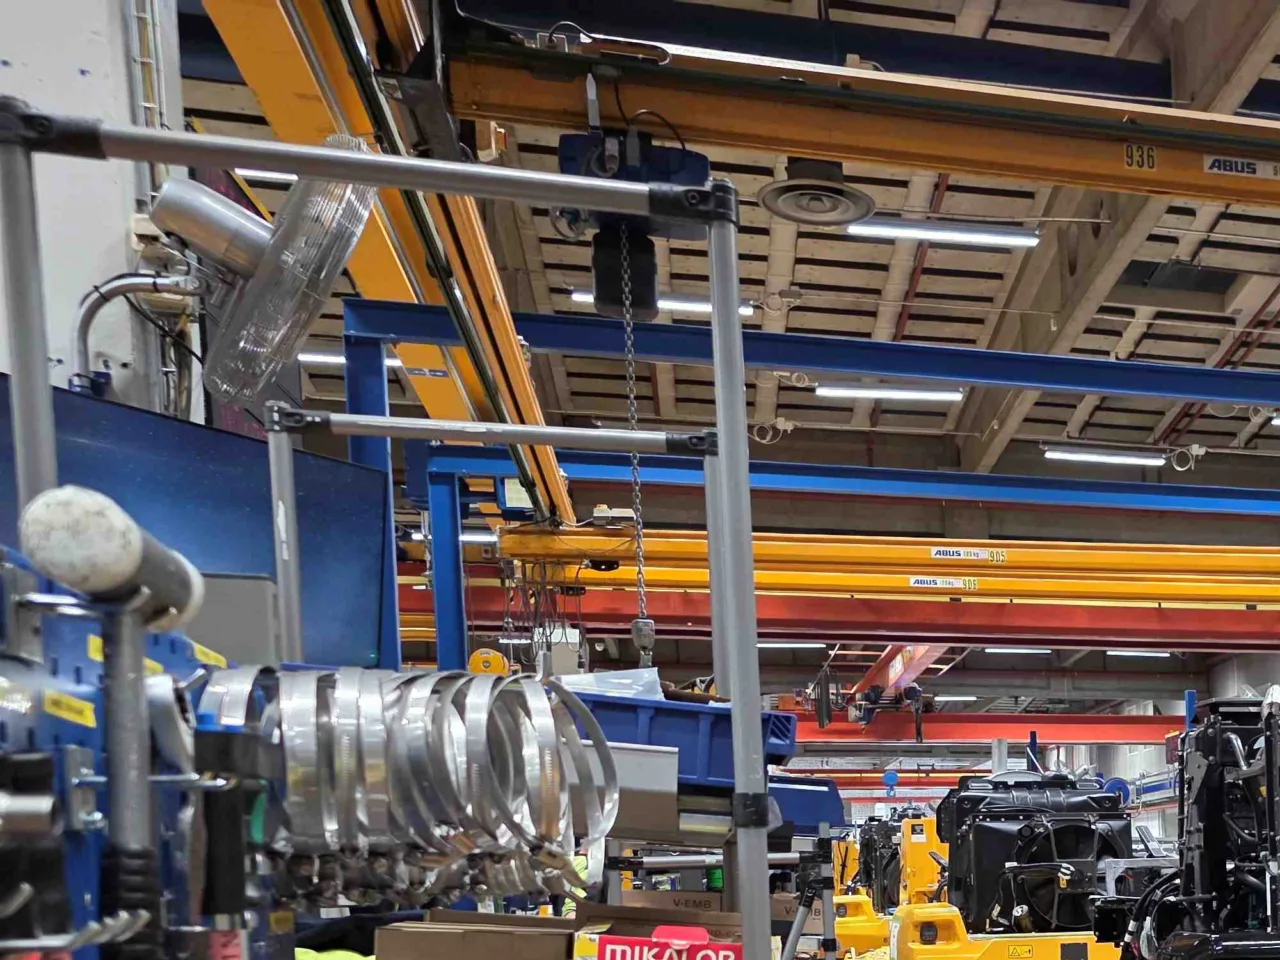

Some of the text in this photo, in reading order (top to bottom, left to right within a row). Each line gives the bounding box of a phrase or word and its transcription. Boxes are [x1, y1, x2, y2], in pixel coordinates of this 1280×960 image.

[1125, 144, 1155, 169] 936
[1208, 158, 1257, 175] ABUS
[934, 549, 961, 557] ABUS
[672, 899, 712, 909] V-EMB
